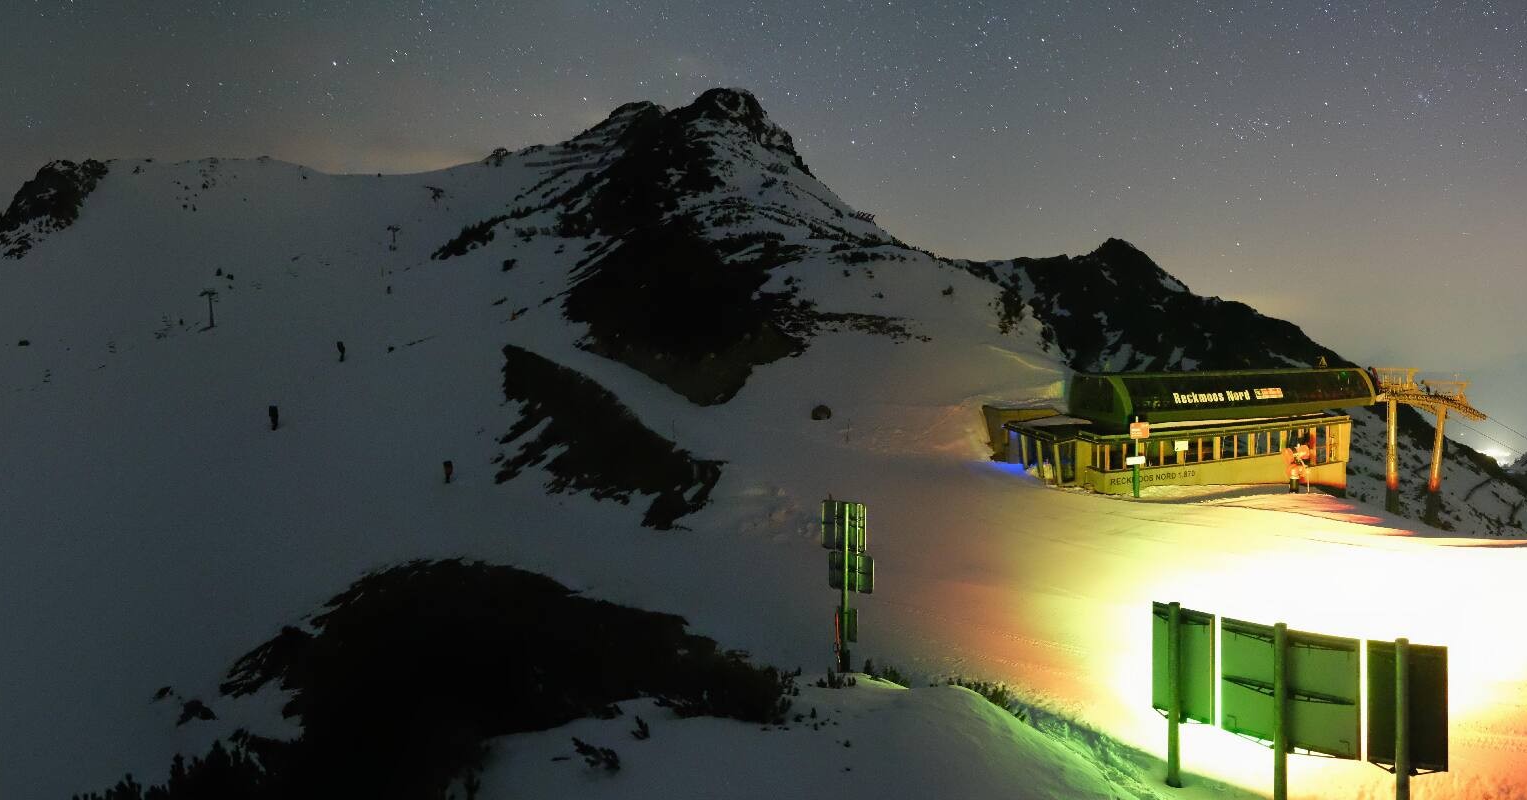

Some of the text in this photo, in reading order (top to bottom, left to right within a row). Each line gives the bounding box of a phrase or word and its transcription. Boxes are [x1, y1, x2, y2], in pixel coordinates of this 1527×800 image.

[1173, 391, 1224, 404] Reckmoos
[1226, 389, 1251, 402] Nord
[1110, 474, 1154, 486] RECKOOS
[1155, 472, 1177, 481] NORD
